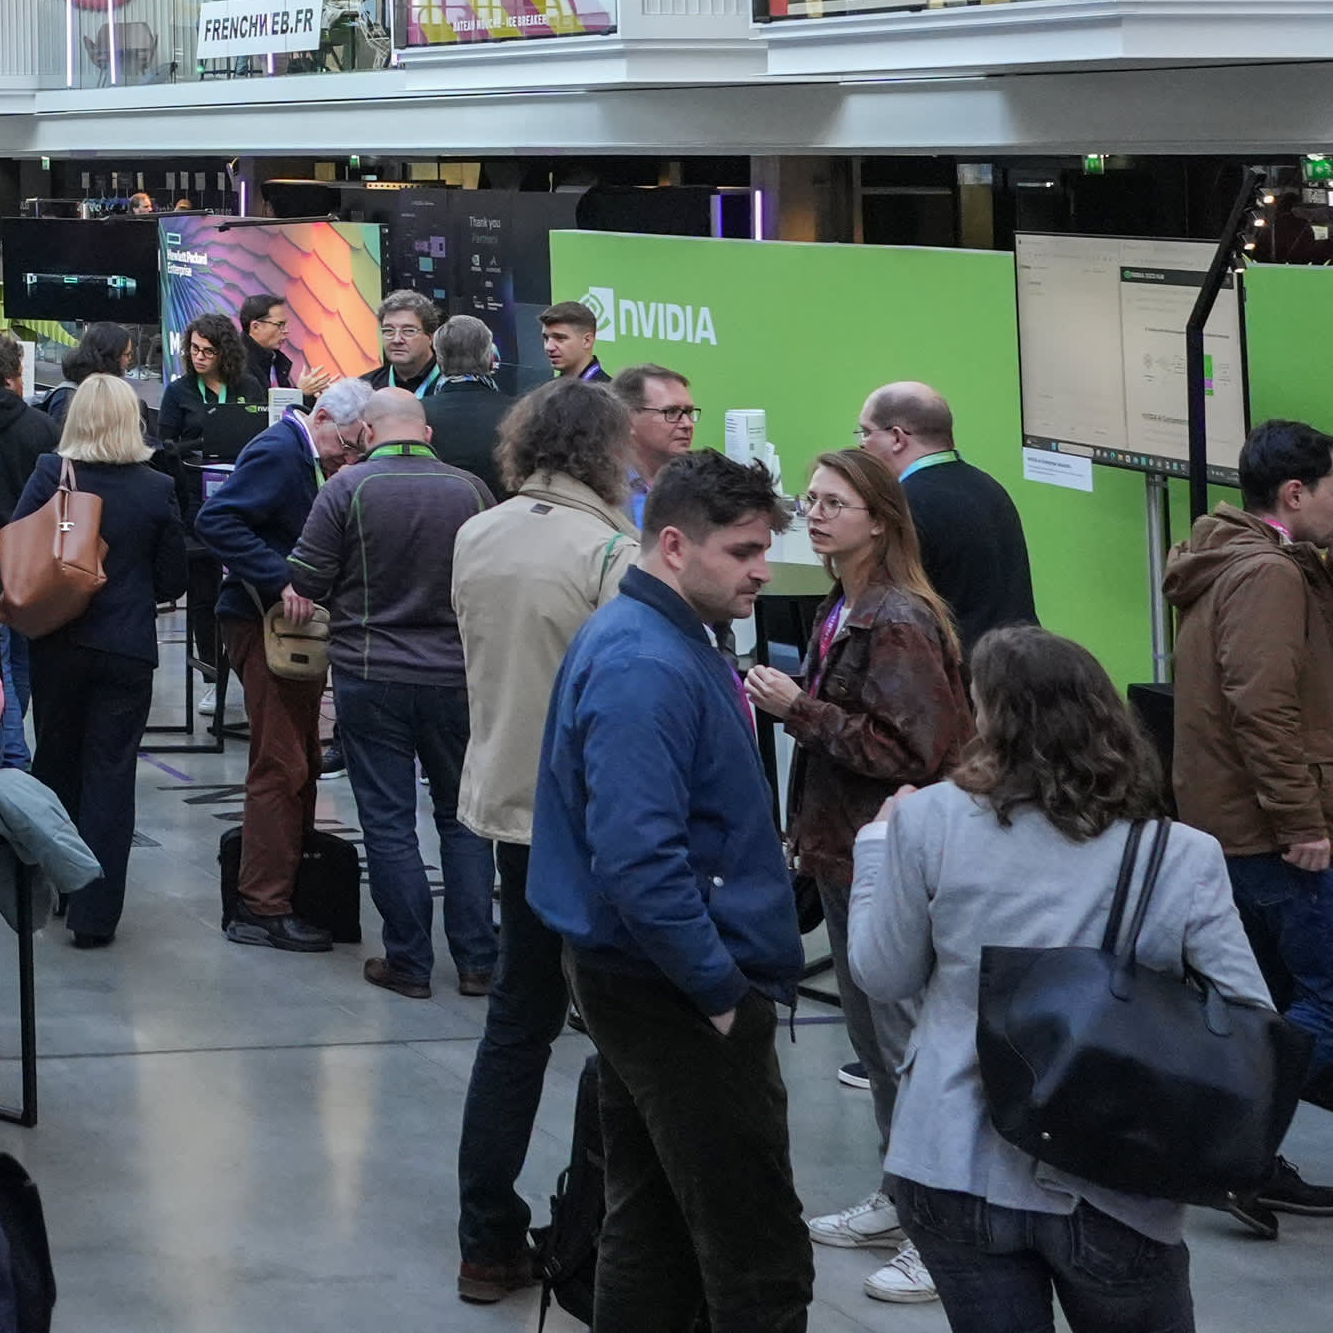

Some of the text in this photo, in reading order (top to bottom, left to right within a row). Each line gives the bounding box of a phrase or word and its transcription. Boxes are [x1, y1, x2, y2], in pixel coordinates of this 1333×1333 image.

[204, 8, 313, 41] FRENCHWEB.FR
[469, 216, 501, 230] Thank you
[167, 249, 208, 266] Hewlett Packard
[167, 262, 193, 277] Enterprise
[619, 299, 718, 345] NVIDIA
